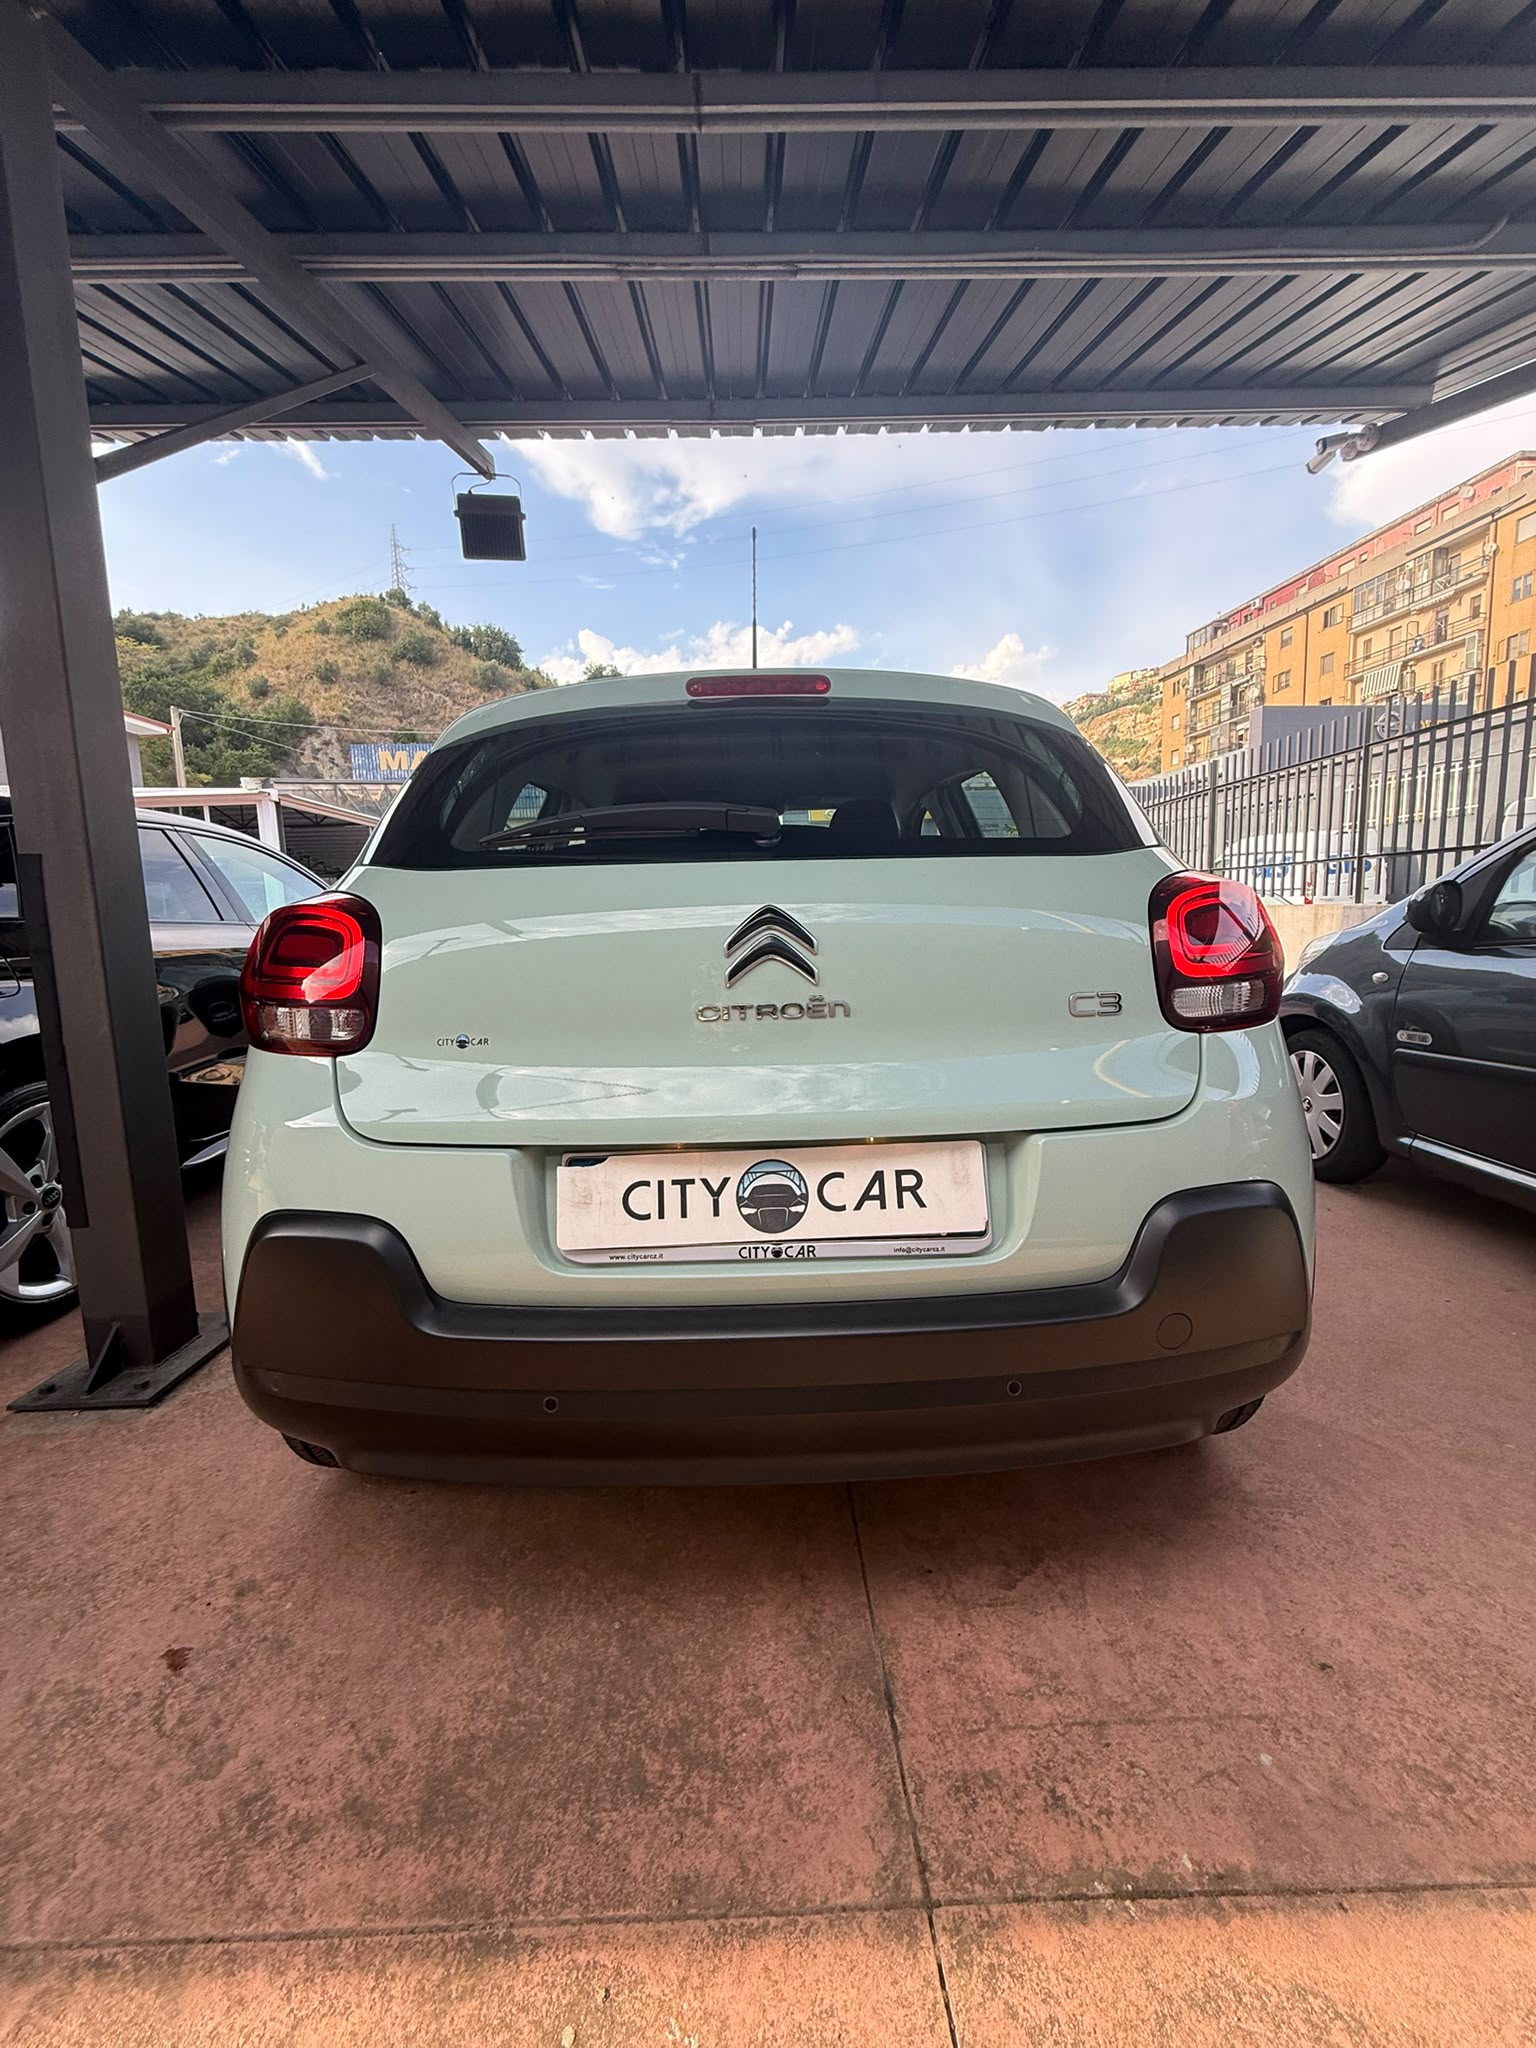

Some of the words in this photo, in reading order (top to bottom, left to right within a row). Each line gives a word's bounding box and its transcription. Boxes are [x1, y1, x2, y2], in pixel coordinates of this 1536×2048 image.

[1068, 991, 1123, 1018] C3
[437, 1038, 455, 1047] CITY
[470, 1037, 489, 1046] CAR
[621, 1176, 731, 1221] CITY
[816, 1168, 928, 1212] CAR
[738, 1246, 769, 1259] CITY
[784, 1245, 817, 1259] CAR
